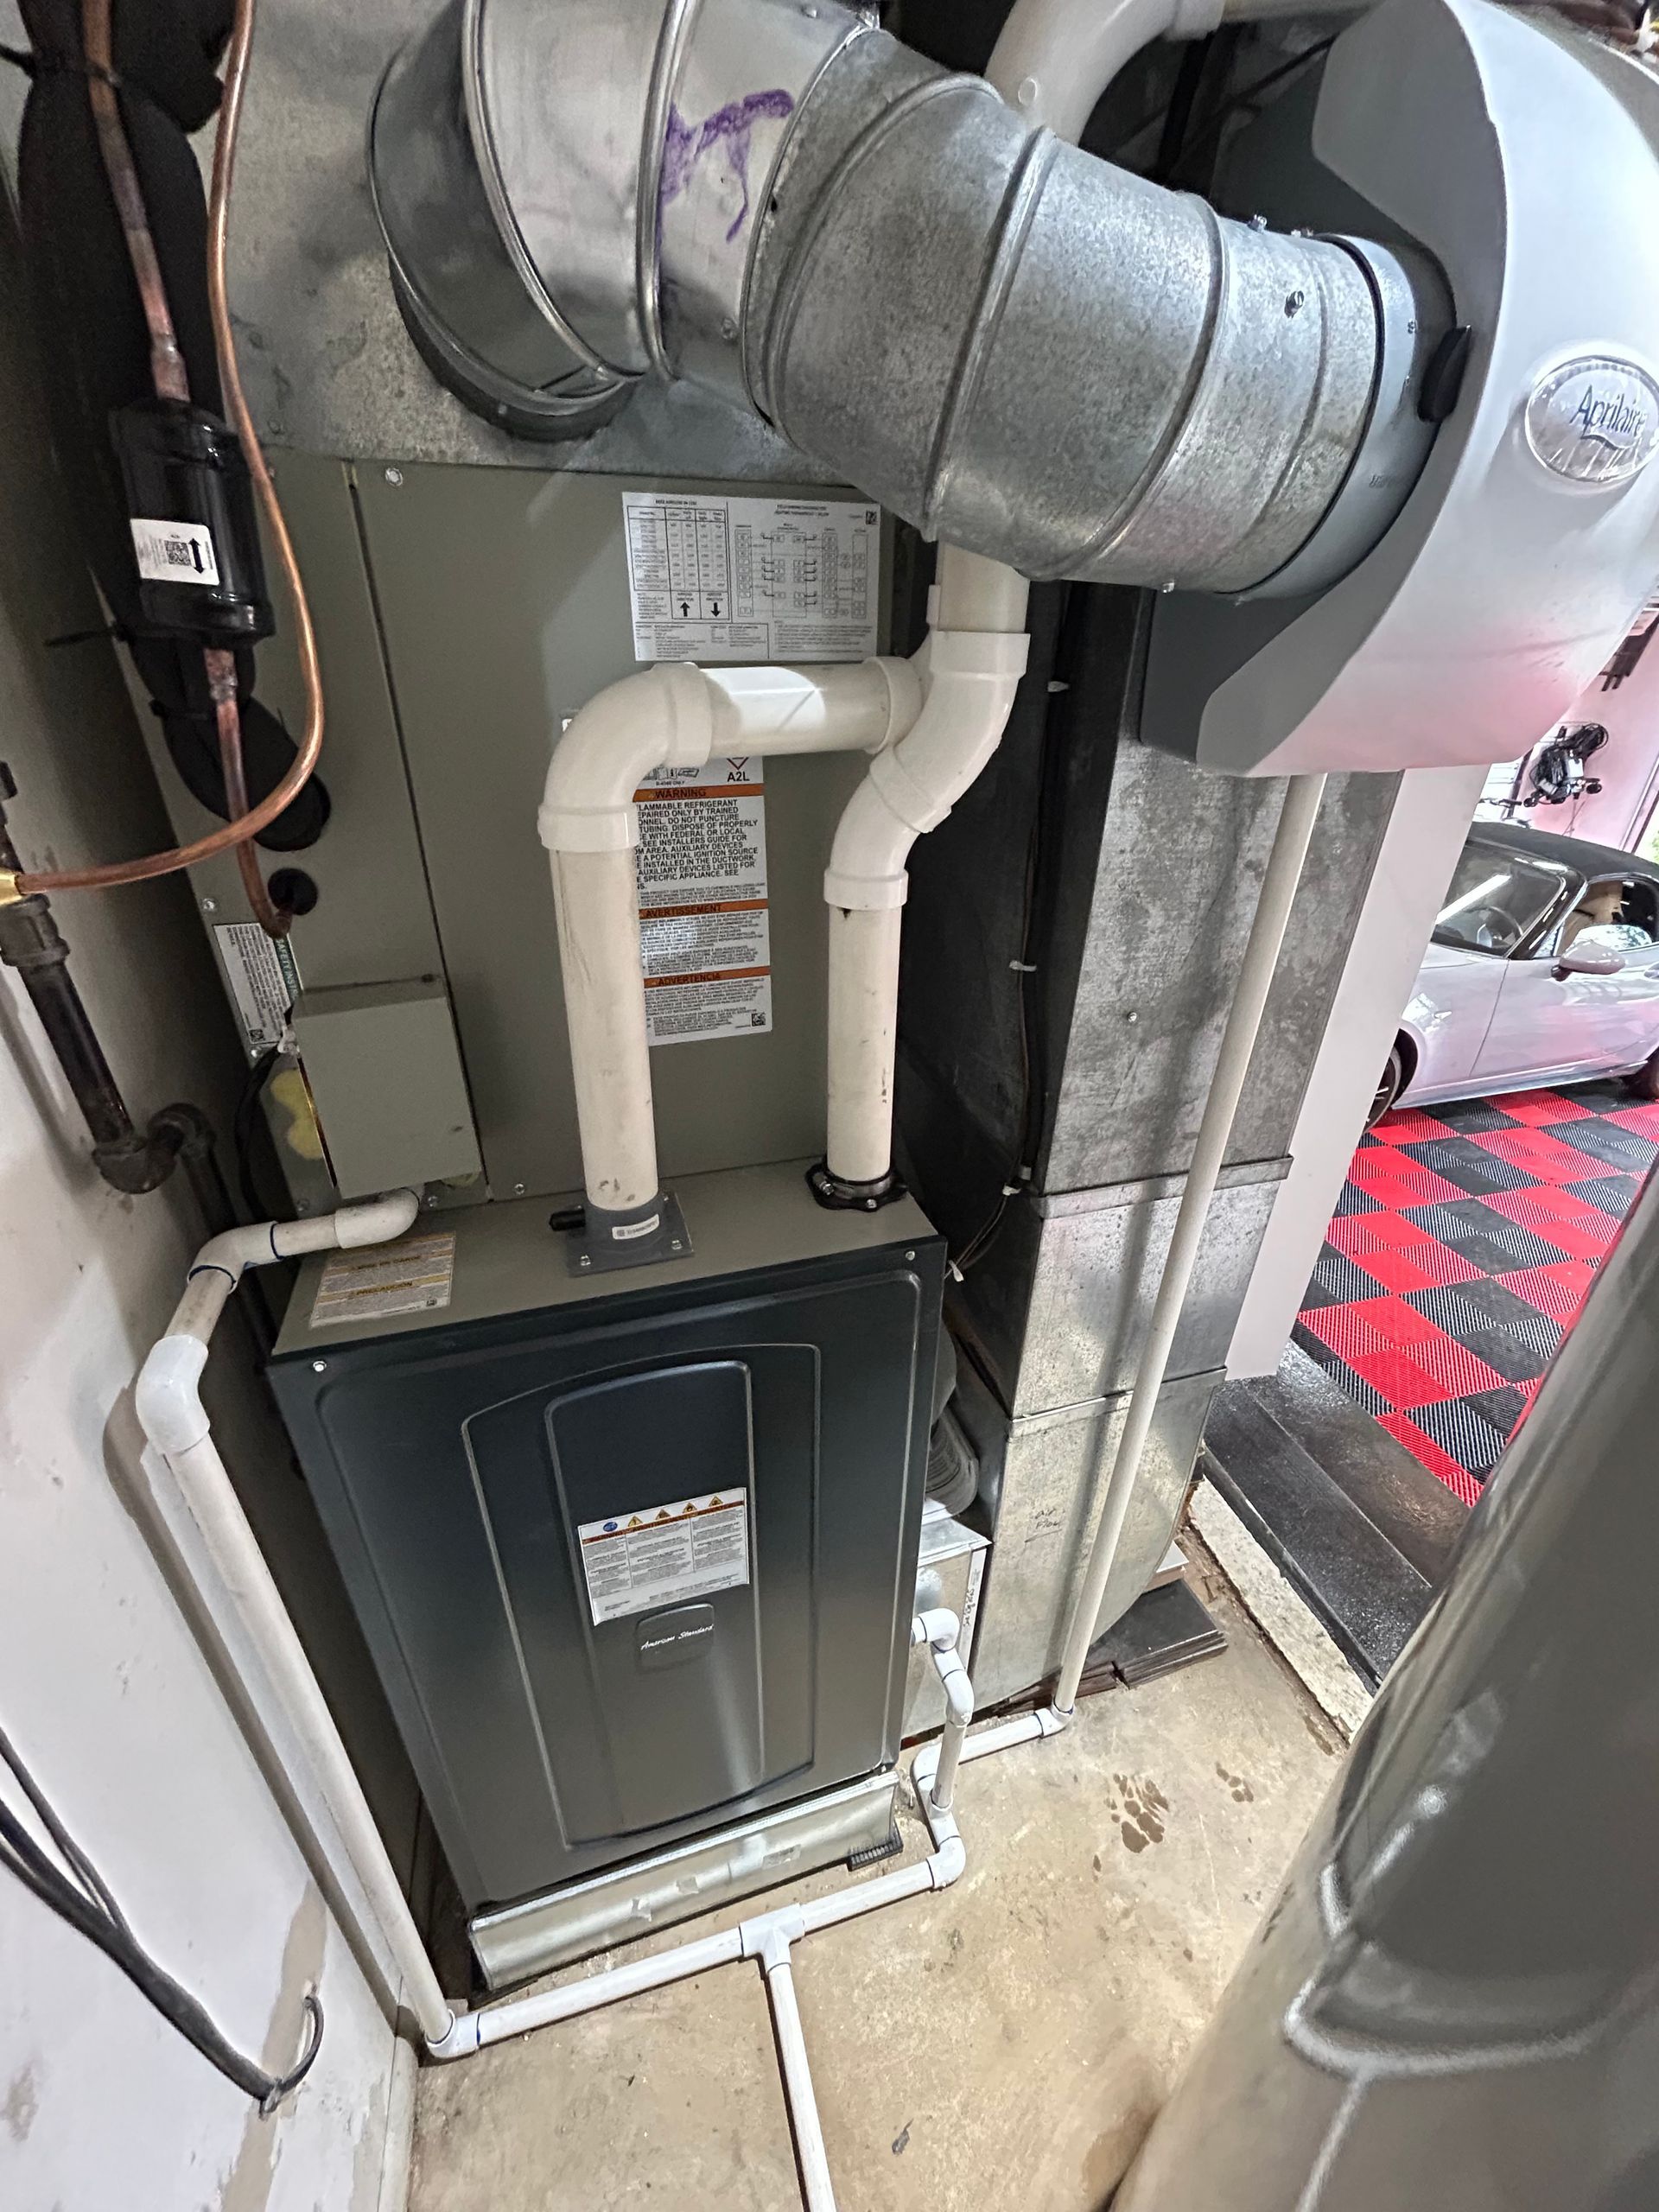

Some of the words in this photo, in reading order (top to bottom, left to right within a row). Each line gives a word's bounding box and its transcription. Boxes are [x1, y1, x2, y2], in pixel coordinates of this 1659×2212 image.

[1569, 385, 1645, 437] Aprilaire
[728, 772, 750, 782] A2L
[655, 788, 706, 798] WARNING
[684, 799, 737, 809] REFRIGERANT
[672, 823, 705, 831] DISPOSE
[649, 831, 669, 840] WITH
[659, 836, 705, 847] INSTALLERS
[671, 843, 709, 852] AUXILIARY
[712, 842, 743, 850] DEVICES
[651, 852, 692, 861] POTENTIAL
[644, 860, 684, 868] INSTALLED
[639, 867, 677, 875] AUXILIARY
[679, 864, 711, 873] DEVICES
[644, 873, 677, 882] SPECIFIC
[646, 904, 721, 918] AVERTISSEMENT
[658, 973, 721, 984] ADVERTENCIA
[640, 1636, 675, 1650] American
[678, 1624, 714, 1639] Standard
